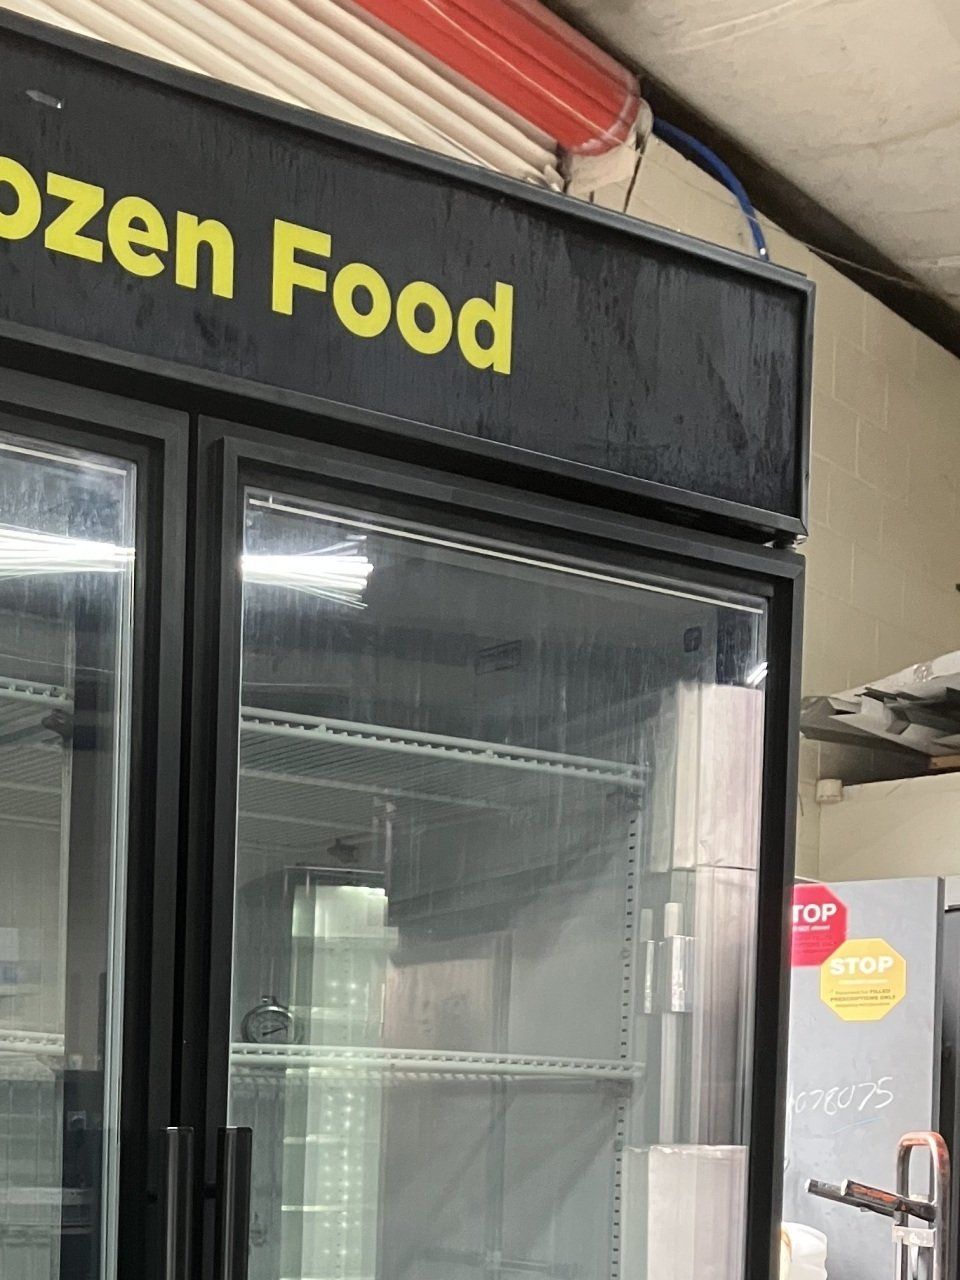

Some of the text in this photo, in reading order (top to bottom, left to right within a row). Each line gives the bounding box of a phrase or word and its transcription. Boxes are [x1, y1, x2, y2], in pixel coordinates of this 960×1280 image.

[271, 218, 514, 375] Food
[792, 903, 837, 923] TOP
[830, 956, 893, 975] STOP
